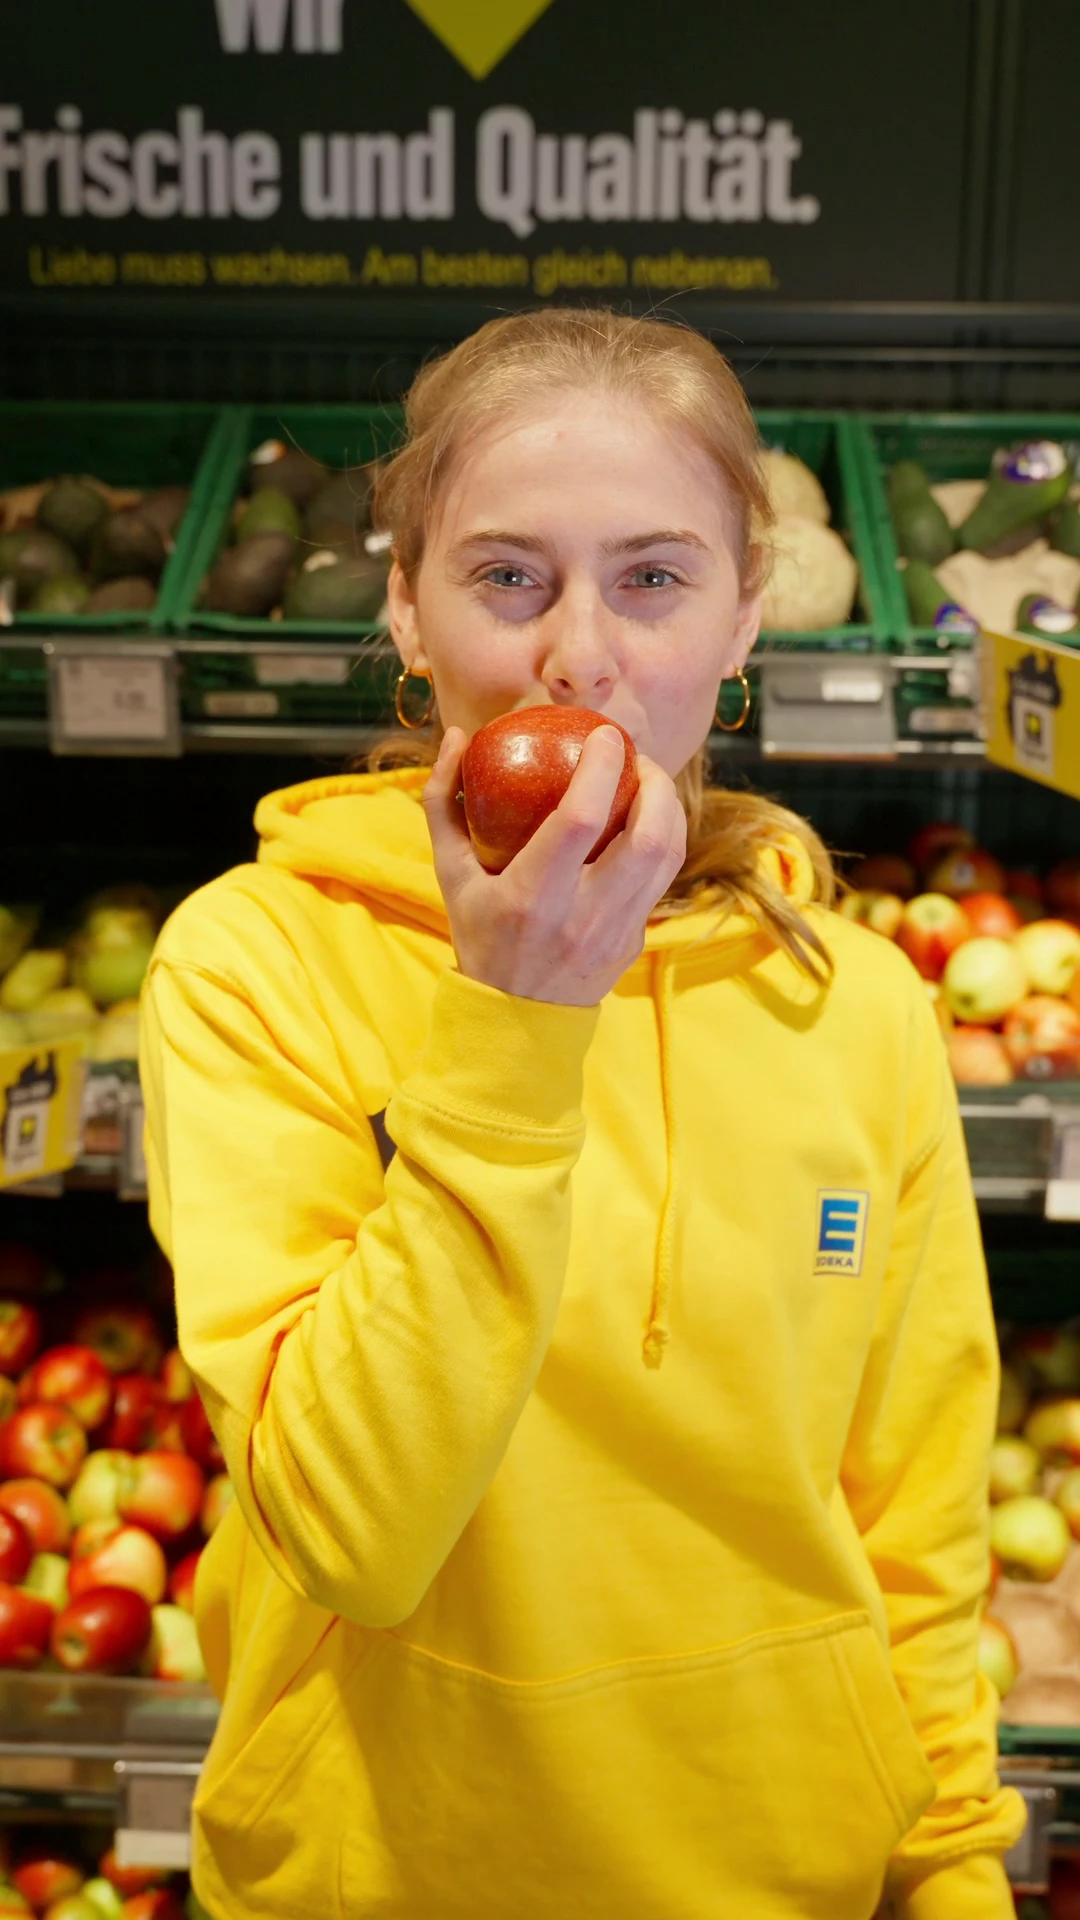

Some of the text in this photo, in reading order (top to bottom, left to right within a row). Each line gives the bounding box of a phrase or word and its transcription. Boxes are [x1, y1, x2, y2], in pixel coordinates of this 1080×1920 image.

[0, 104, 820, 239] Frische und Qualität.
[28, 247, 117, 286] Liebe
[361, 246, 418, 285] Am
